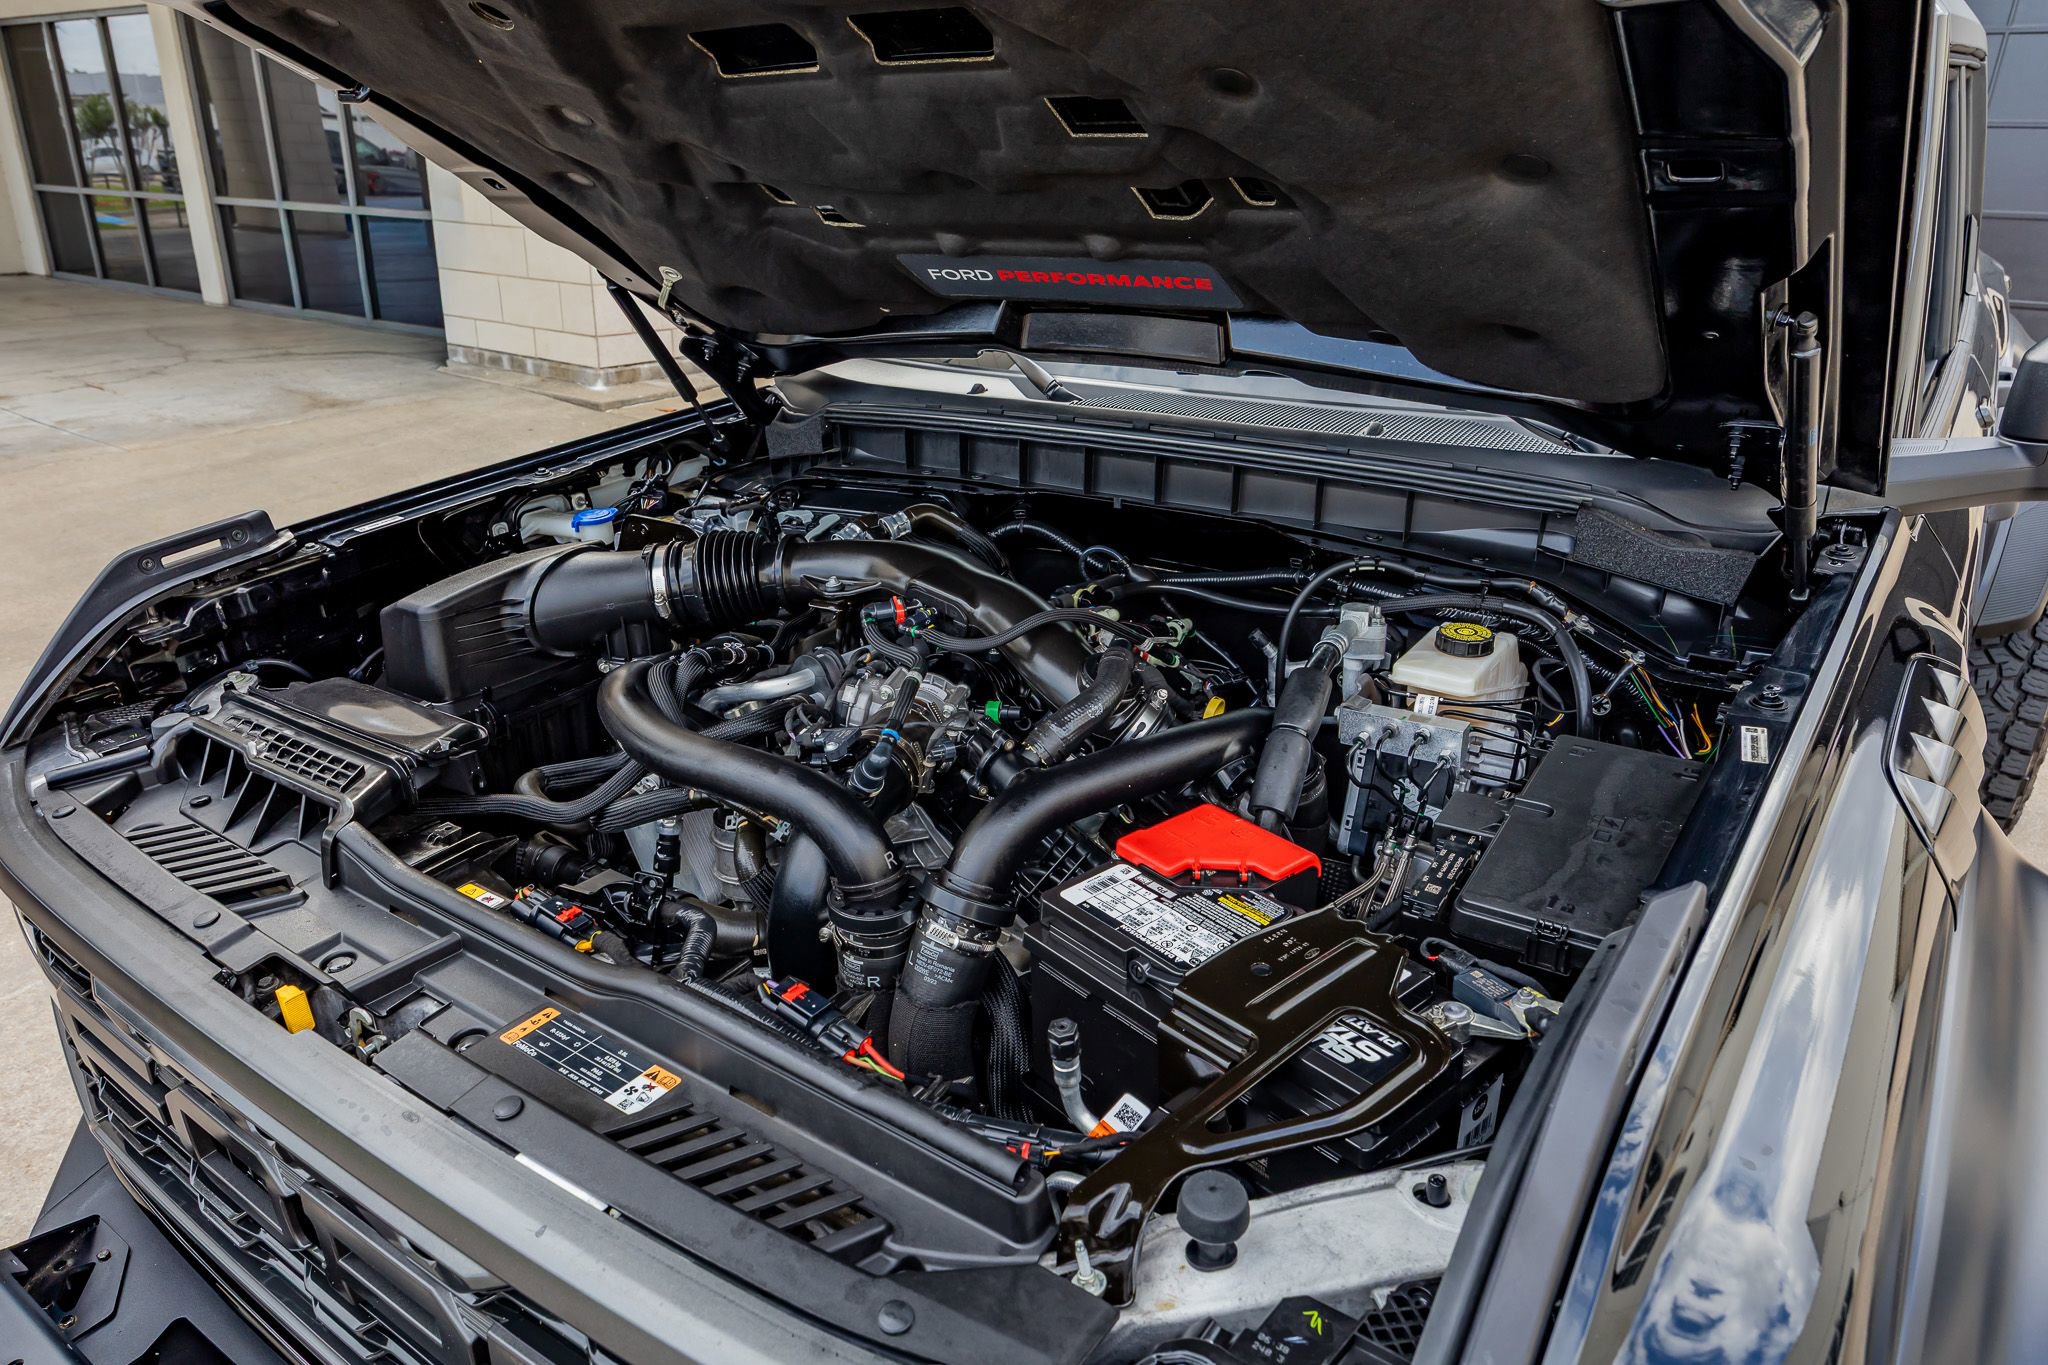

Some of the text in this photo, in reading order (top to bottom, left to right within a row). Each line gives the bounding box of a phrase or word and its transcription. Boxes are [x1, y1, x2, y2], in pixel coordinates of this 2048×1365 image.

[927, 268, 1213, 290] FORD PERFORMANCE
[884, 851, 898, 870] R
[867, 976, 880, 988] R
[512, 1039, 538, 1057] FoMoCo
